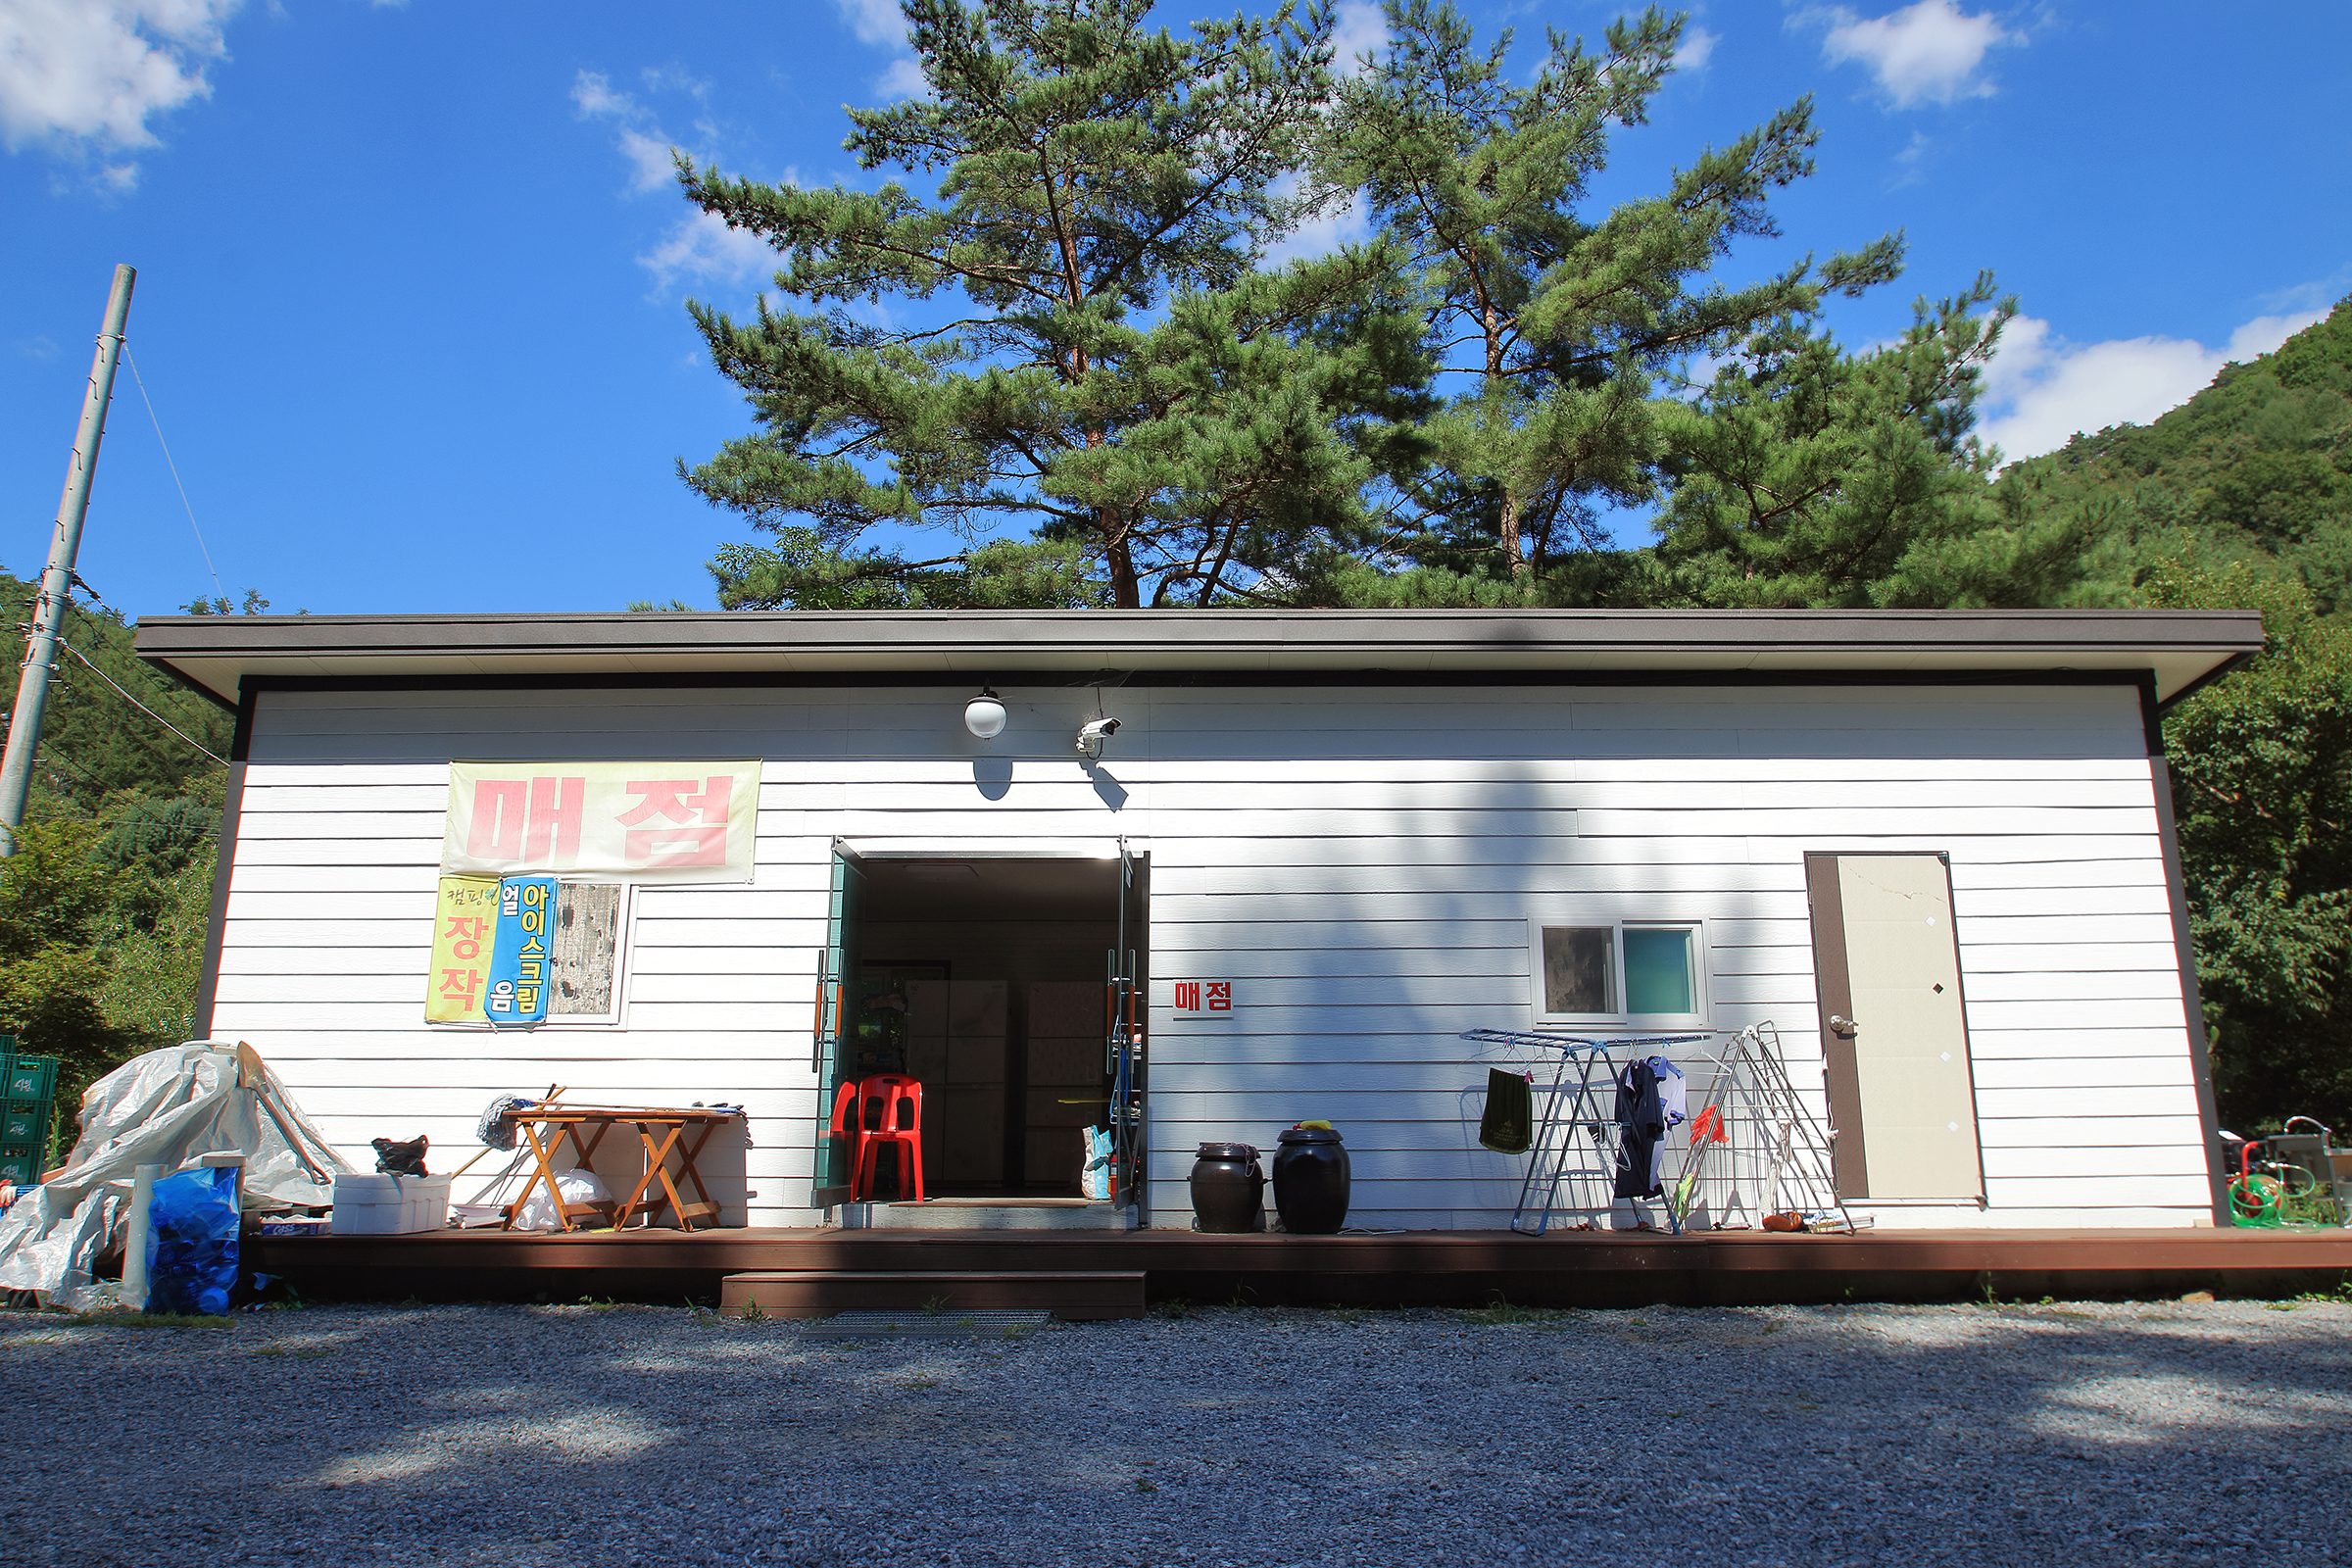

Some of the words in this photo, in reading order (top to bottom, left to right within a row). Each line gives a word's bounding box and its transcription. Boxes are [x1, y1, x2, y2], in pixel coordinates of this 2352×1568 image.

[466, 776, 734, 868] 매점
[447, 888, 484, 906] 캠핑
[438, 916, 489, 1012] 장작
[516, 884, 551, 1015] 아이스크림
[1175, 981, 1232, 1011] 매점
